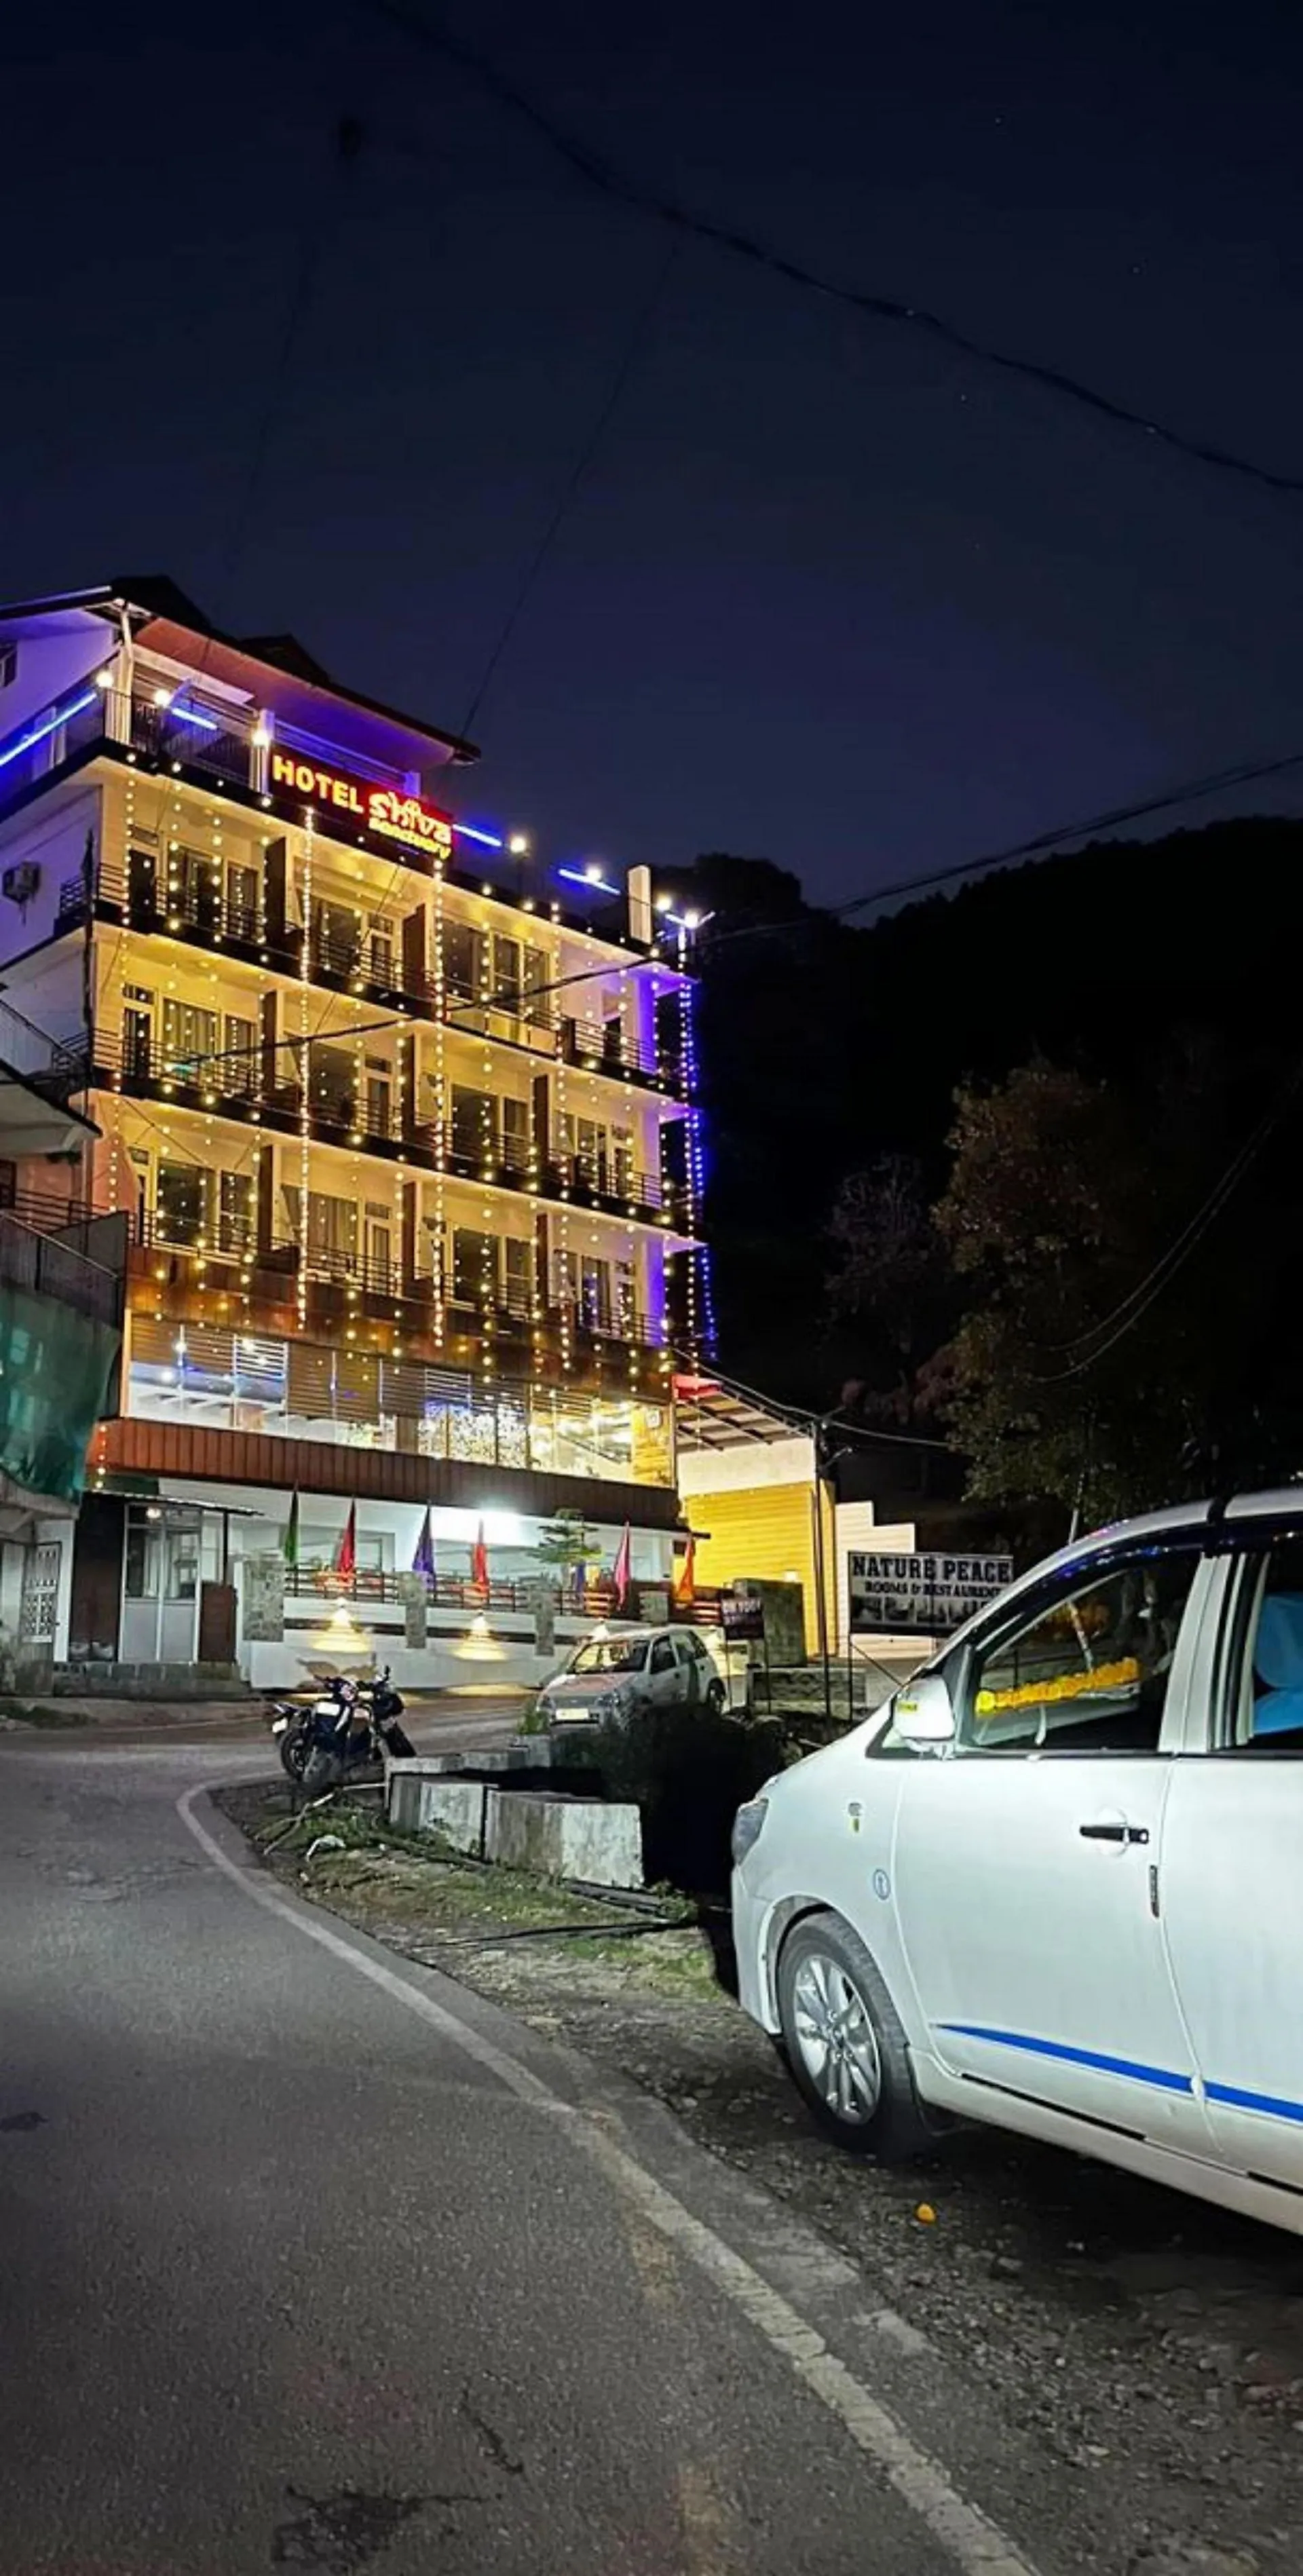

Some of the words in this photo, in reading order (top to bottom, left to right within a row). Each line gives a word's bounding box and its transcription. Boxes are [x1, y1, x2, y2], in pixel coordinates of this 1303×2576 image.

[273, 754, 364, 814] HOTEL
[369, 791, 452, 845] Shiva
[852, 1555, 935, 1579] NATURE
[943, 1560, 1010, 1583] PEACE
[865, 1580, 908, 1594] ROOMS
